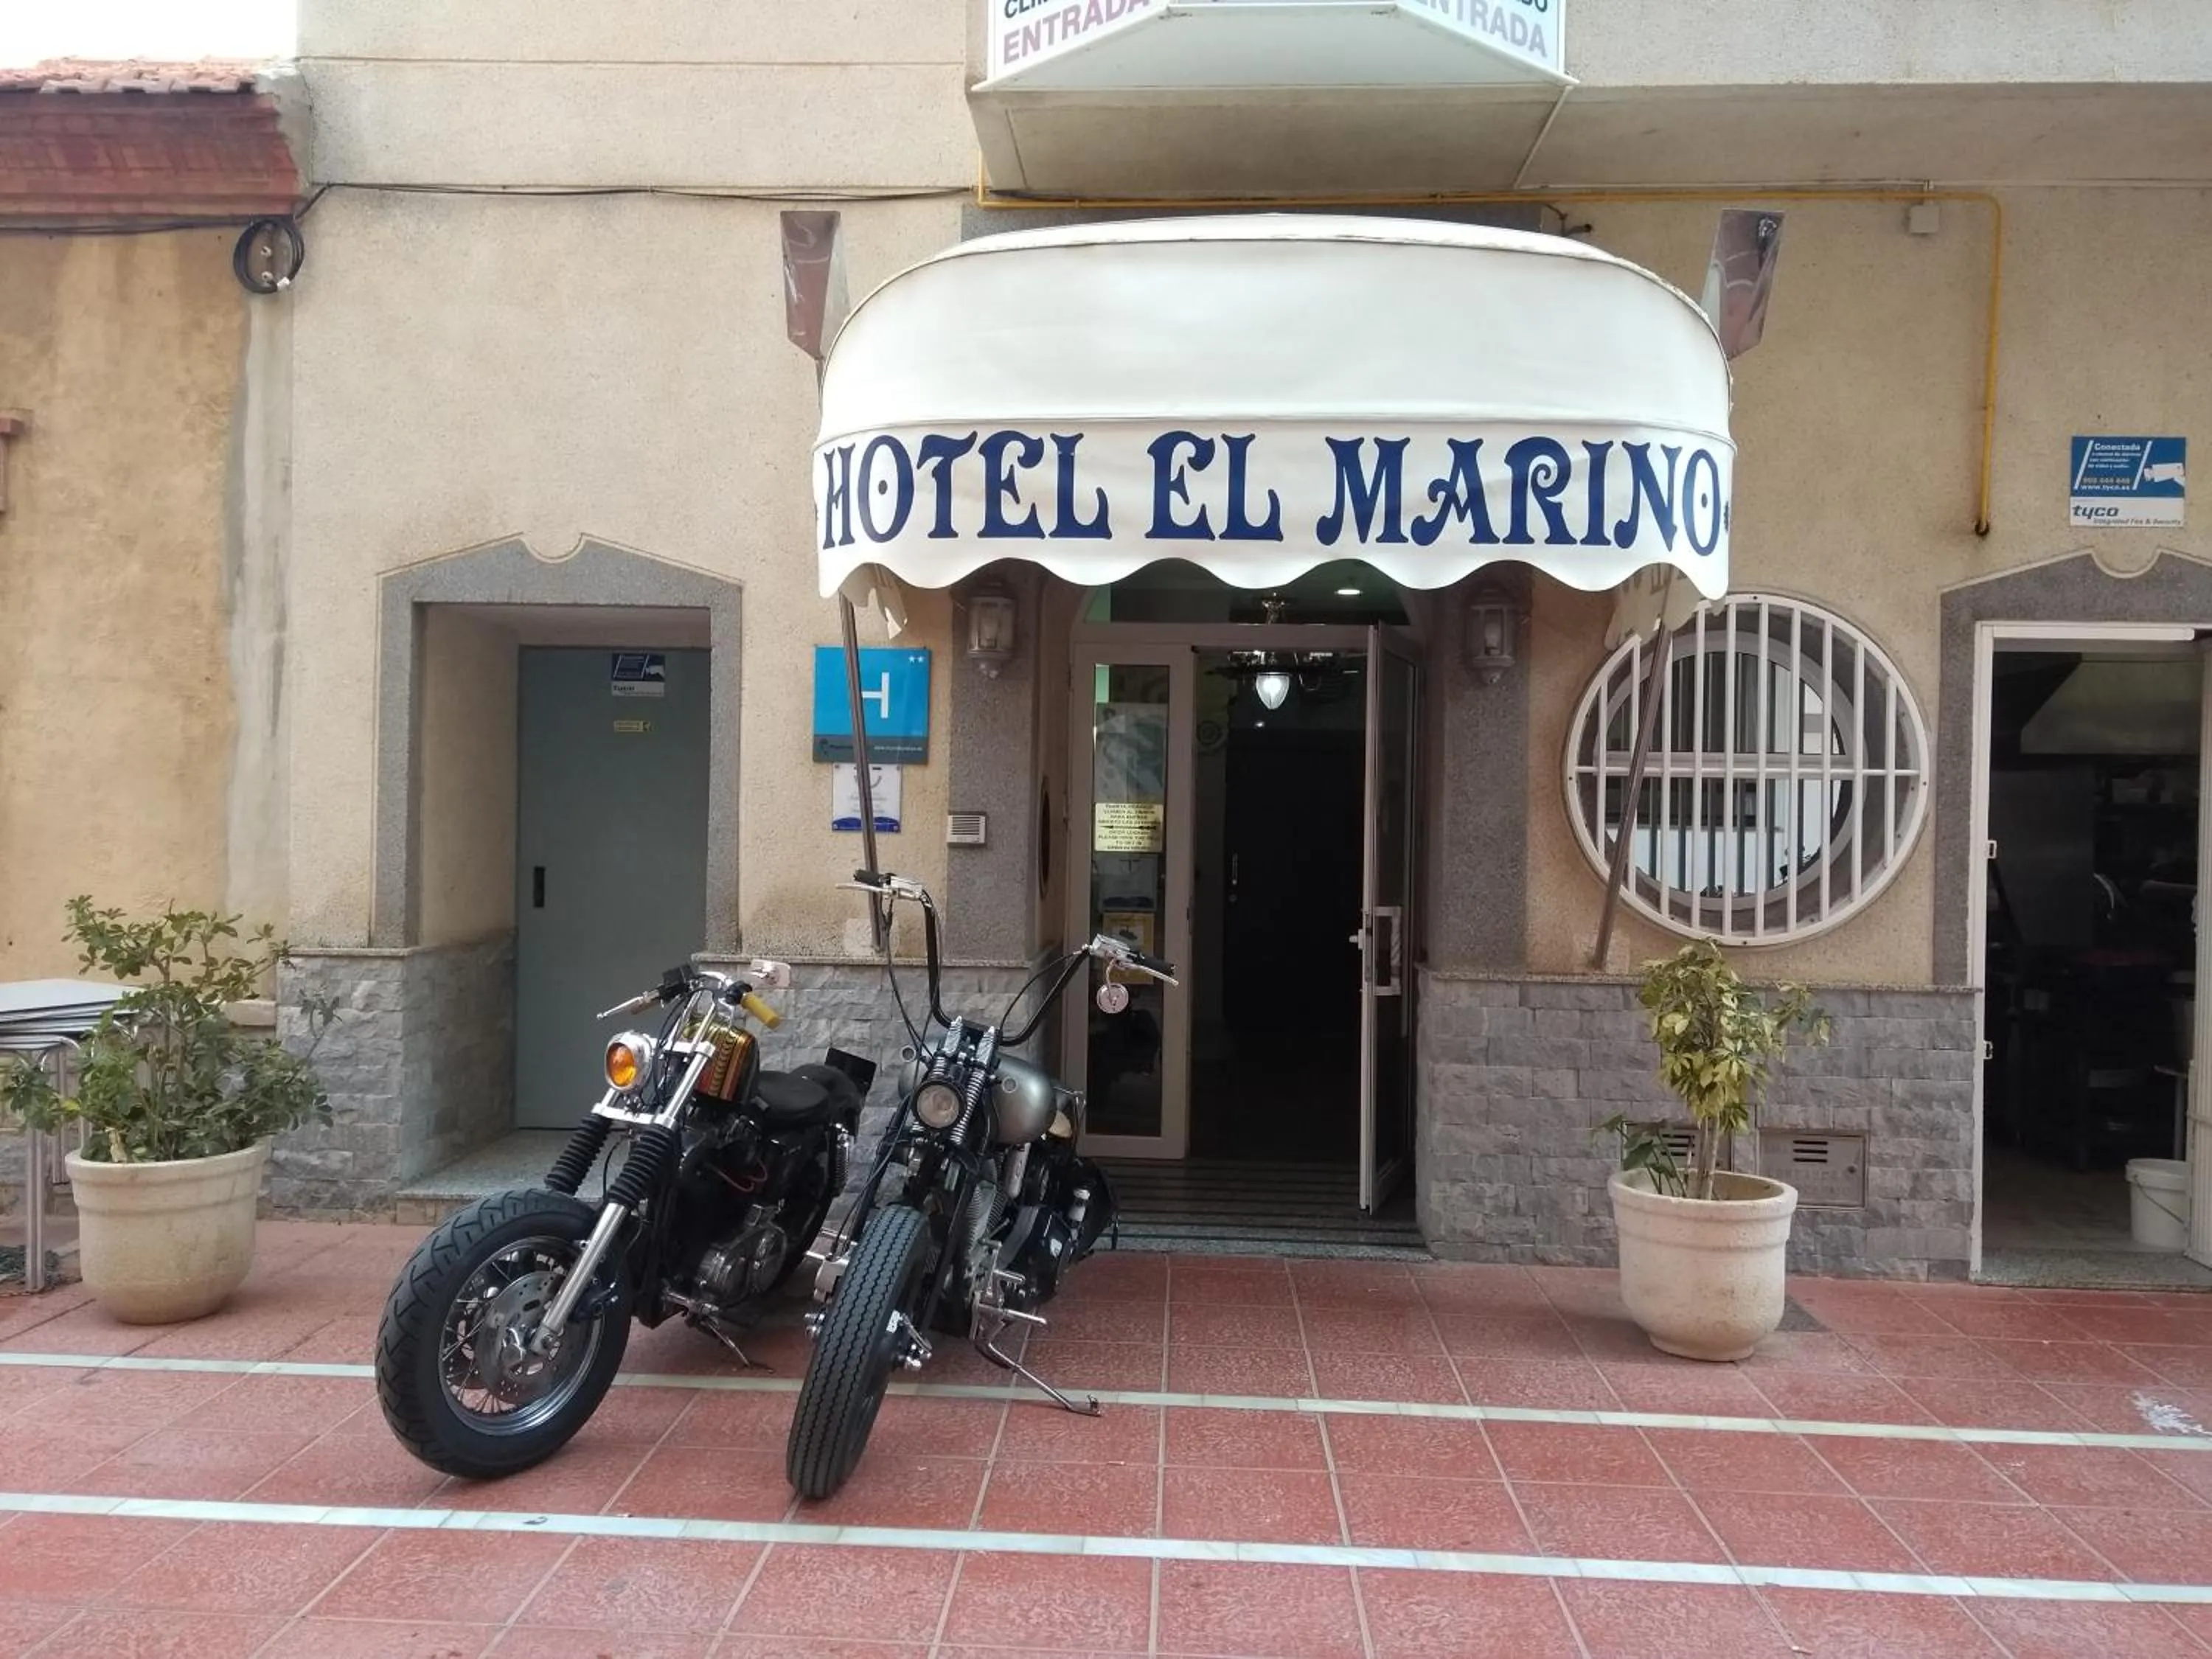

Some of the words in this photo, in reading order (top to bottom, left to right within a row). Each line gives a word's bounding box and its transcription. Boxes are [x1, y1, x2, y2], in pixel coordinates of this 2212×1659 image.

[823, 431, 1112, 549] HOTEL
[1144, 430, 1284, 541] EL
[1316, 436, 1722, 557] MARINO
[2073, 505, 2119, 519] tyco
[858, 672, 890, 719] H
